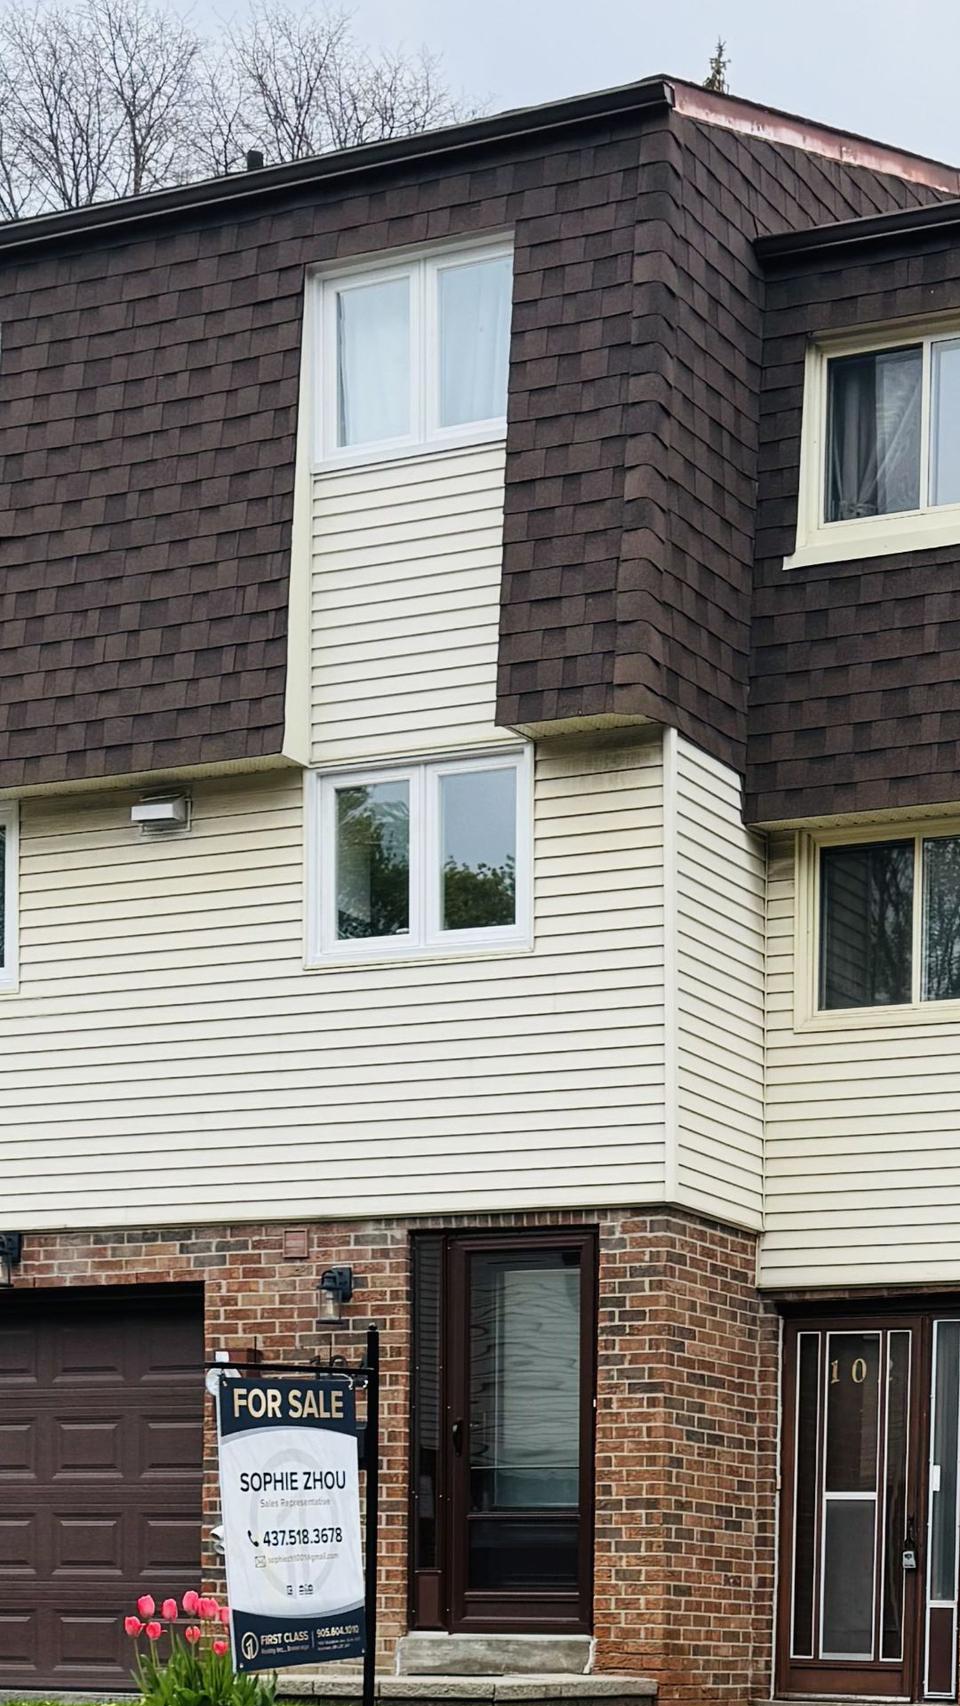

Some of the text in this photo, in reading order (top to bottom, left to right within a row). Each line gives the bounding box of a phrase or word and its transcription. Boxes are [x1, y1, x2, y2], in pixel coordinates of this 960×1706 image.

[233, 1388, 344, 1418] FOR SALE
[240, 1471, 346, 1492] SOPHIE ZHOU
[260, 1498, 331, 1508] Sales Representative
[263, 1527, 343, 1547] 437.518.3678
[260, 1633, 282, 1645] FIRST
[283, 1630, 309, 1643] CLASS
